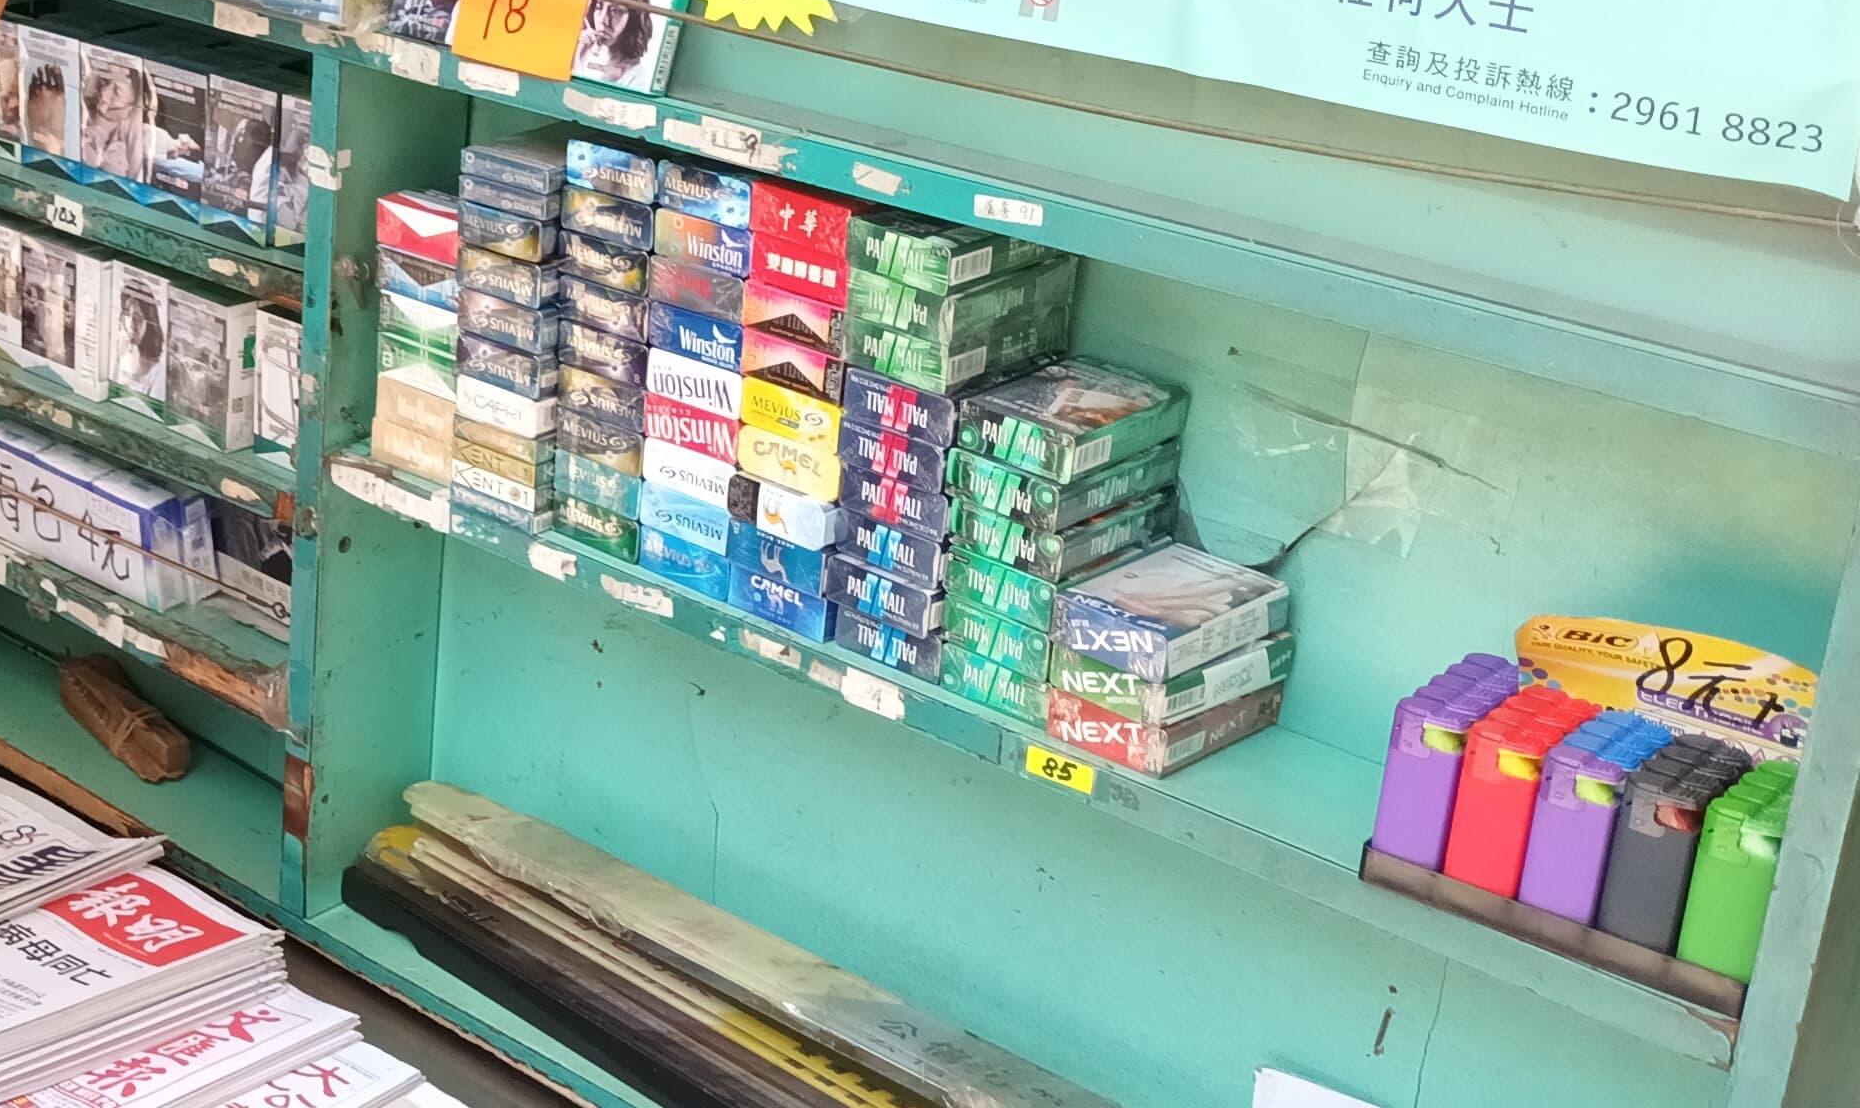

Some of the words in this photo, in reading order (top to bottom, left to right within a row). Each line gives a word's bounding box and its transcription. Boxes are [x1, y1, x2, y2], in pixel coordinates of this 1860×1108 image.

[1365, 39, 1576, 103] 查詢及投訴熱線
[1362, 68, 1413, 93] Enquiry
[1416, 79, 1442, 97] and
[1445, 84, 1515, 112] Complaint
[1518, 98, 1569, 123] Hotline
[1721, 111, 1826, 154] 8823
[664, 177, 712, 201] MEVIUS
[778, 202, 818, 239] 中華
[687, 232, 743, 269] Winston
[679, 325, 736, 364] Winston
[653, 372, 733, 413] Winston
[866, 390, 895, 418] MALL
[751, 394, 802, 423] MEVIUS
[900, 400, 928, 429] PALL
[646, 412, 735, 459] Winston
[858, 435, 886, 465] MALL
[752, 439, 823, 478] CAMEL
[892, 448, 918, 476] PALL
[678, 469, 727, 496] MEVIUS
[861, 480, 887, 509] PALL
[893, 492, 922, 521] MALL
[675, 513, 723, 541] MEVIUS
[856, 526, 882, 555] PALL
[887, 537, 915, 568] MALL
[750, 574, 804, 608] CAMEL
[846, 574, 872, 603] PALL
[877, 586, 905, 617] MALL
[1072, 593, 1138, 619] NEXT
[858, 623, 885, 652] MALL
[891, 635, 918, 665] PALL
[1070, 630, 1155, 654] NEXT
[1061, 669, 1140, 696] NEXT
[1059, 721, 1143, 744] NEXT
[1042, 757, 1078, 782] 85
